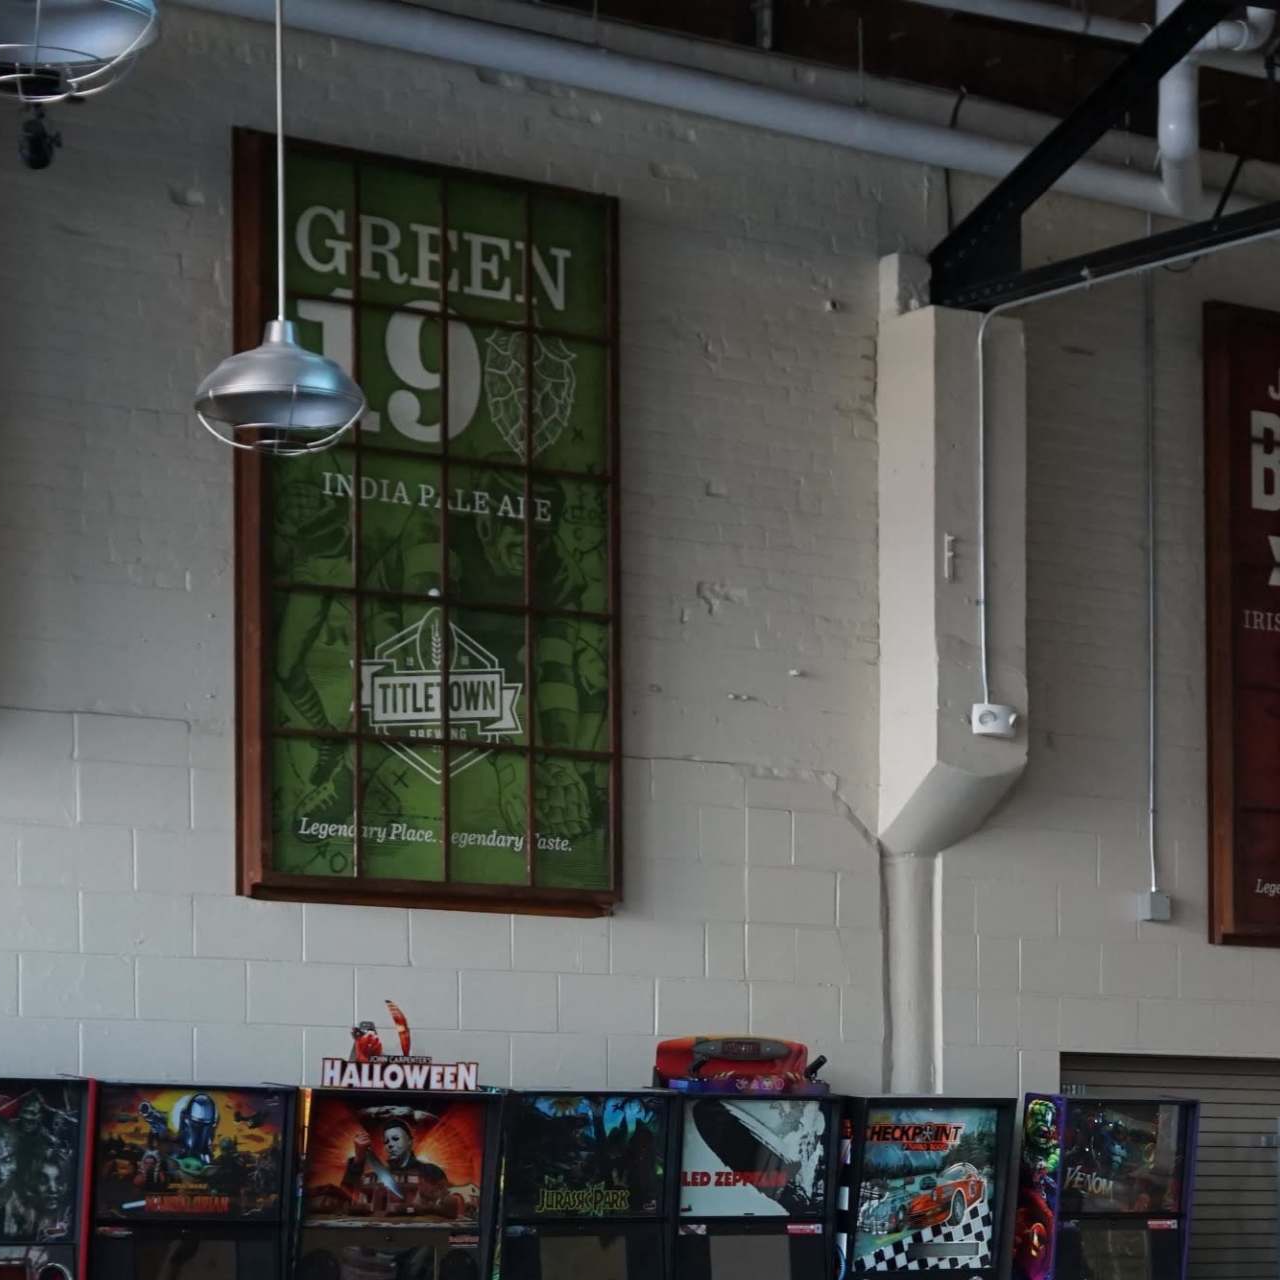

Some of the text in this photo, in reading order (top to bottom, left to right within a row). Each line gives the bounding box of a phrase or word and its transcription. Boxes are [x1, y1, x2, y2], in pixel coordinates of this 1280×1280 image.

[295, 205, 572, 311] GREEN
[297, 288, 481, 443] 19
[322, 471, 411, 506] INDIA
[418, 483, 489, 515] PLE
[409, 728, 467, 740] BREWNG
[389, 823, 437, 843] Place.
[442, 829, 524, 852] egendary
[533, 832, 572, 852] aste.
[322, 1058, 479, 1091] HALLOWEEN
[680, 1171, 711, 1187] LED
[1064, 1165, 1113, 1199] VENOM
[536, 1188, 631, 1213] JURASSIC PARK
